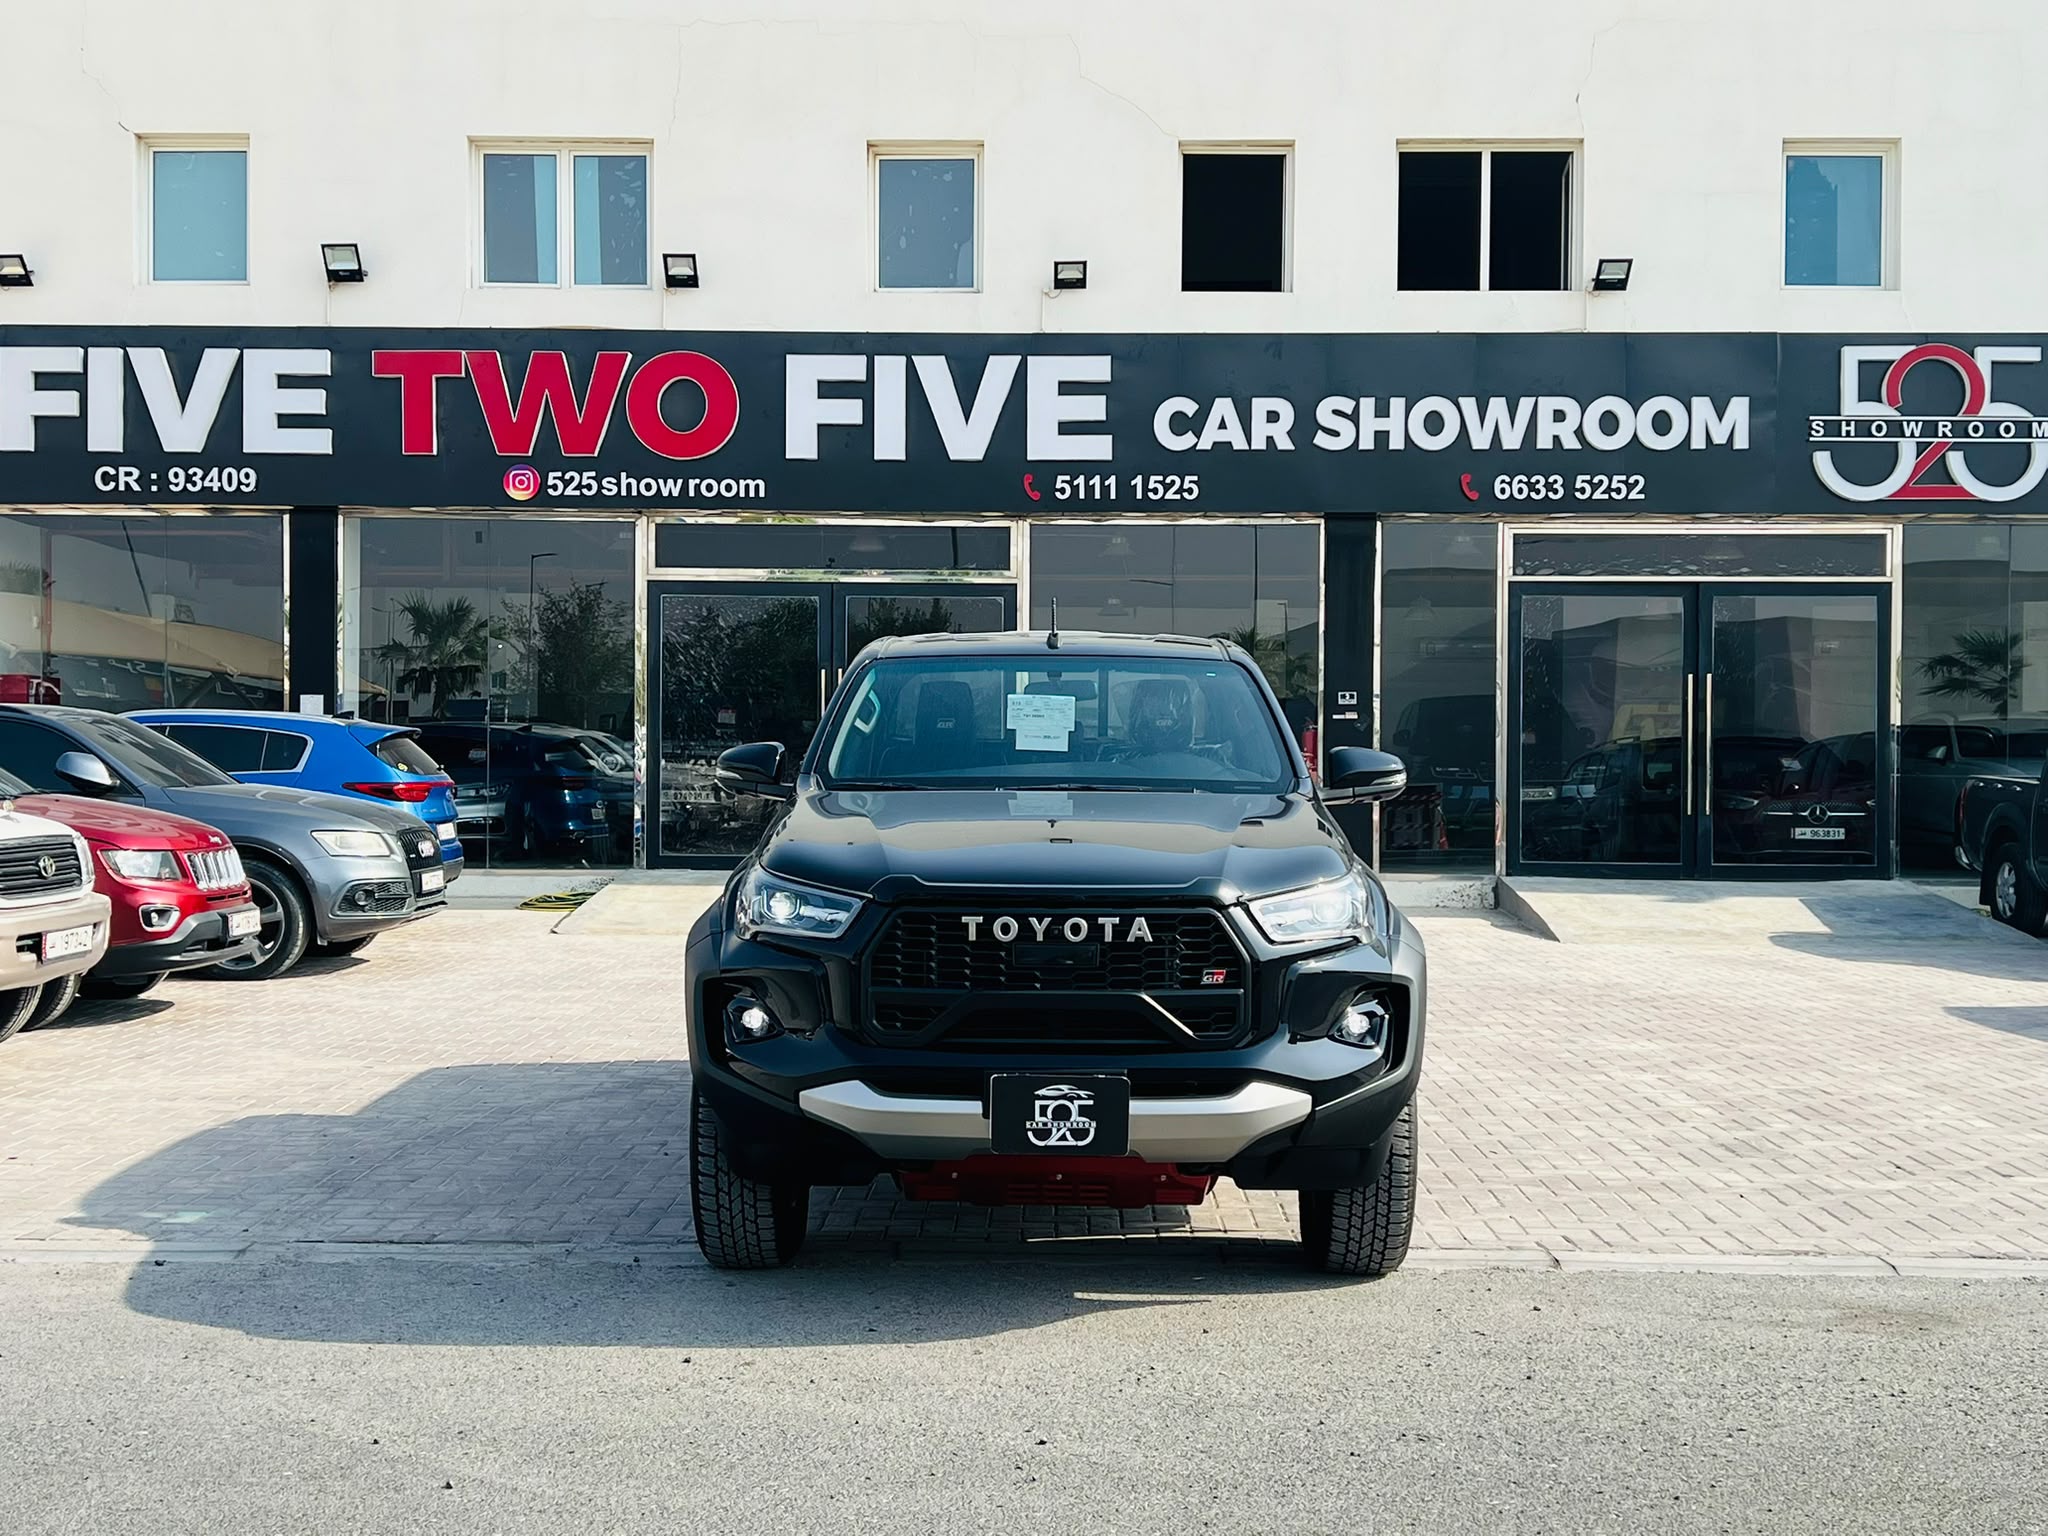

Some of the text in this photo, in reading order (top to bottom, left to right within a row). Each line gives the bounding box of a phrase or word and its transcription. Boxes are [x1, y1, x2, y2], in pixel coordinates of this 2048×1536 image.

[0, 346, 1113, 461] FIVE TWO FIVE
[1153, 395, 1750, 452] CAR SHOWROOM
[1810, 420, 2048, 438] SHOWROOM
[94, 466, 142, 492] CR
[167, 466, 257, 493] 93409
[1054, 474, 1199, 500] 5111 1525
[1493, 474, 1646, 500] 6633 5252
[961, 915, 1154, 943] TOYOTA
[1202, 972, 1225, 984] GR
